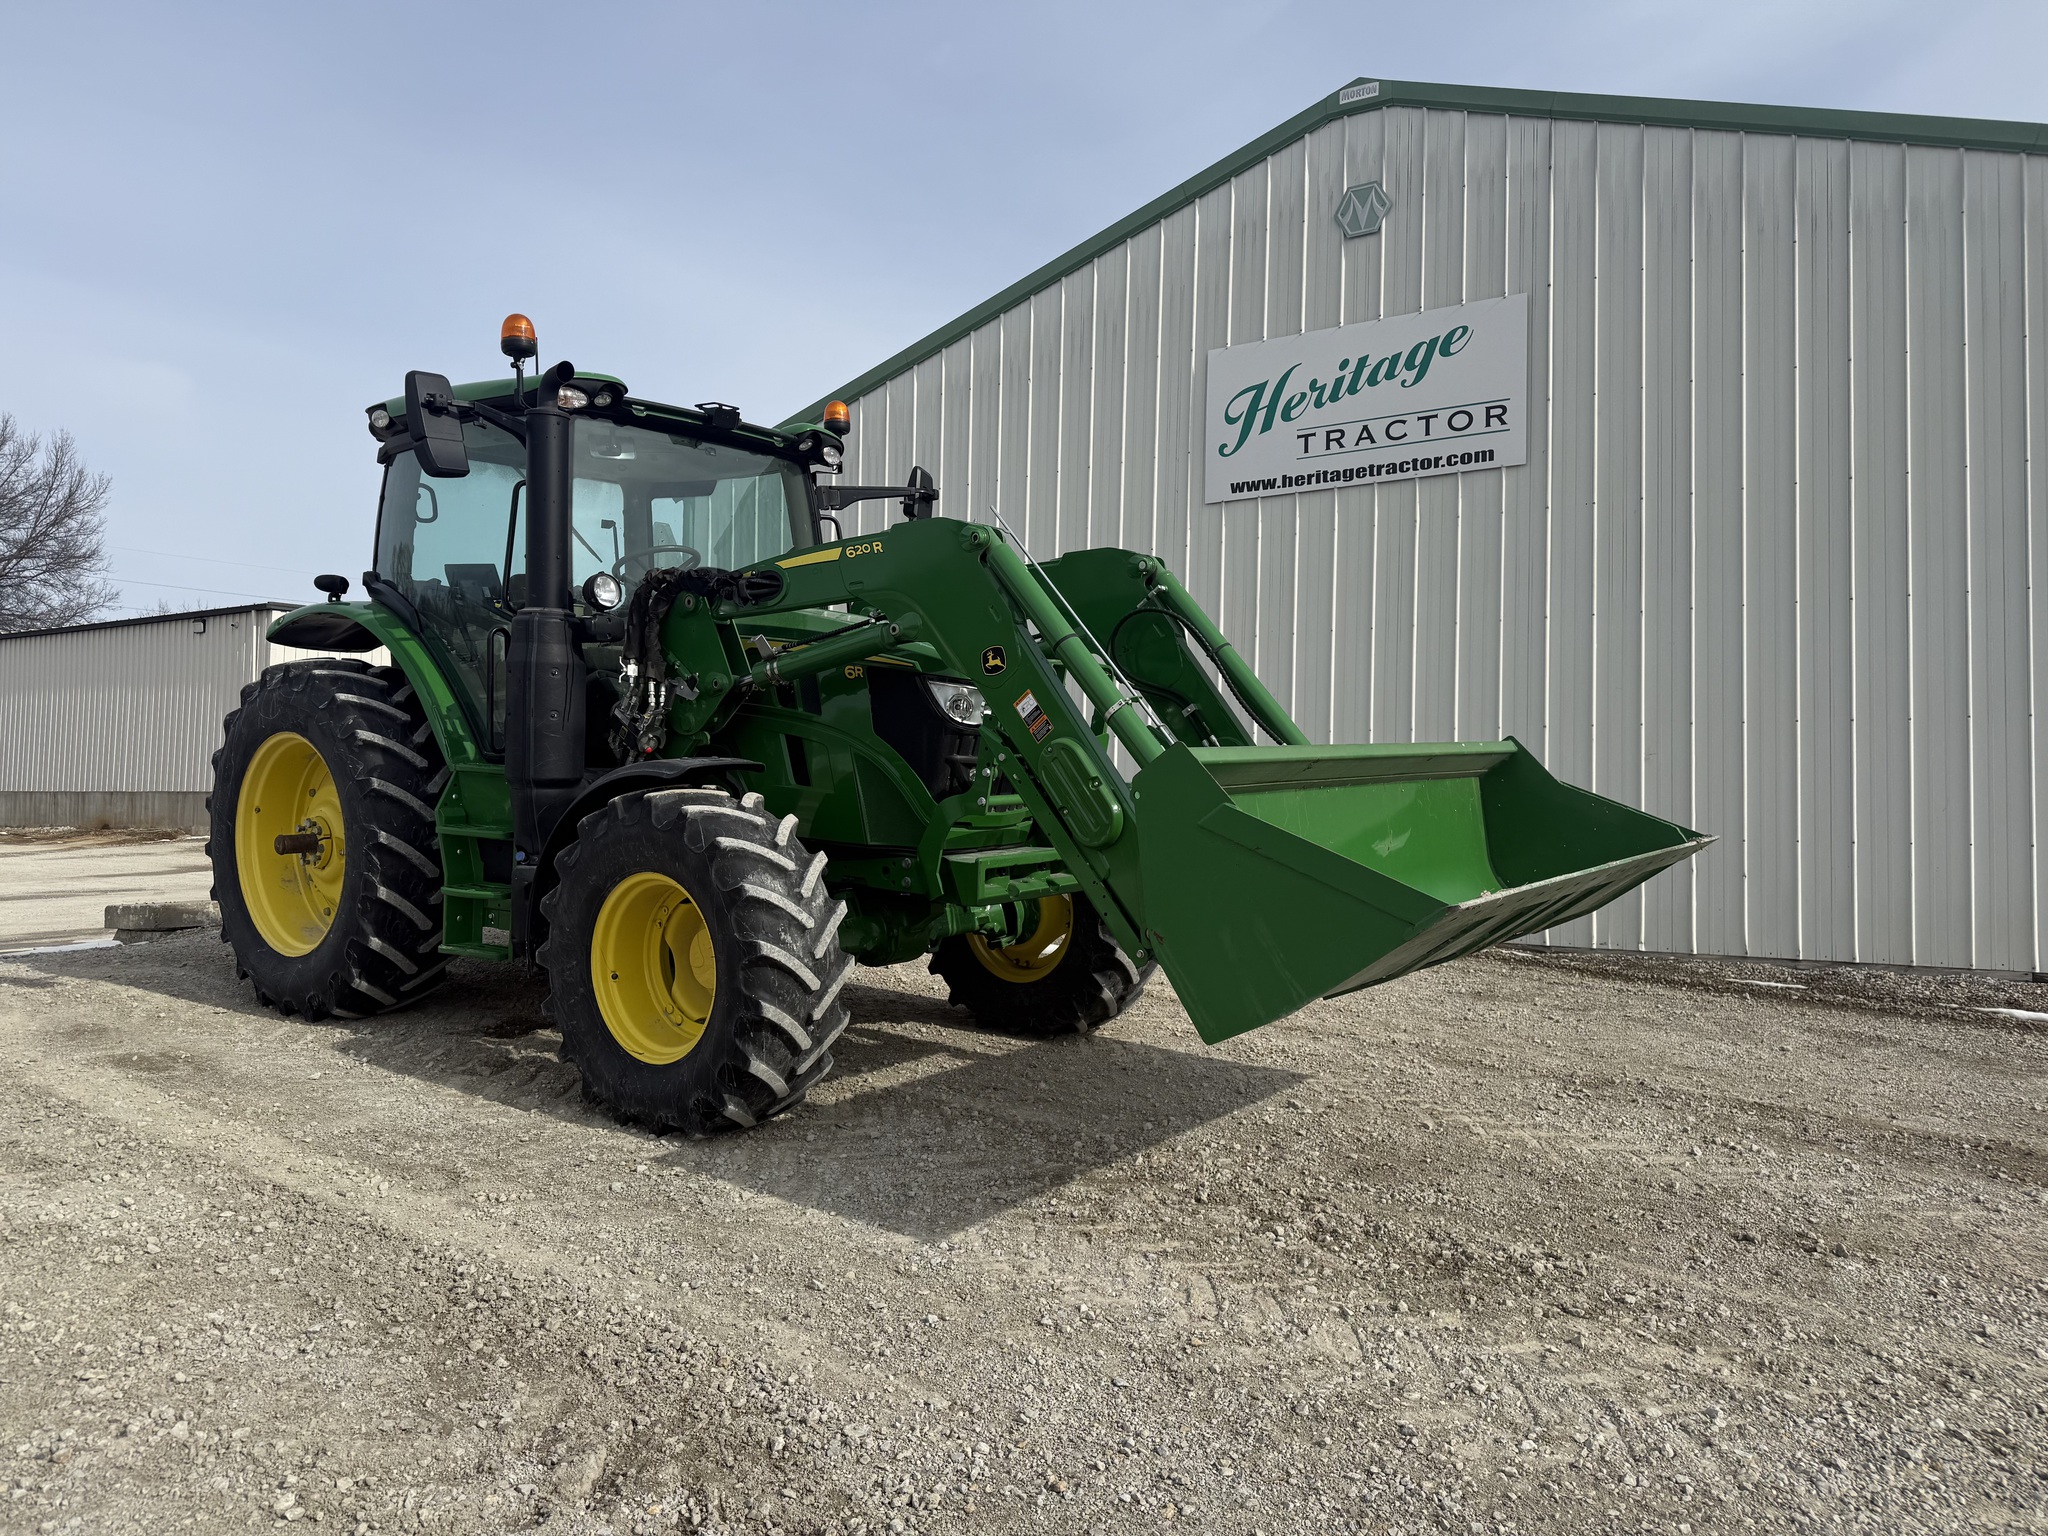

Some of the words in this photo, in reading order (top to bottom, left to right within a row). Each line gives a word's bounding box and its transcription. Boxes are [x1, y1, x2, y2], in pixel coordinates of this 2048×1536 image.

[1341, 85, 1377, 101] MORTON
[1218, 325, 1474, 457] Heritage
[1297, 404, 1508, 453] TRACTOR
[1230, 448, 1495, 493] www.heritagetractor.com
[844, 665, 864, 679] 6R
